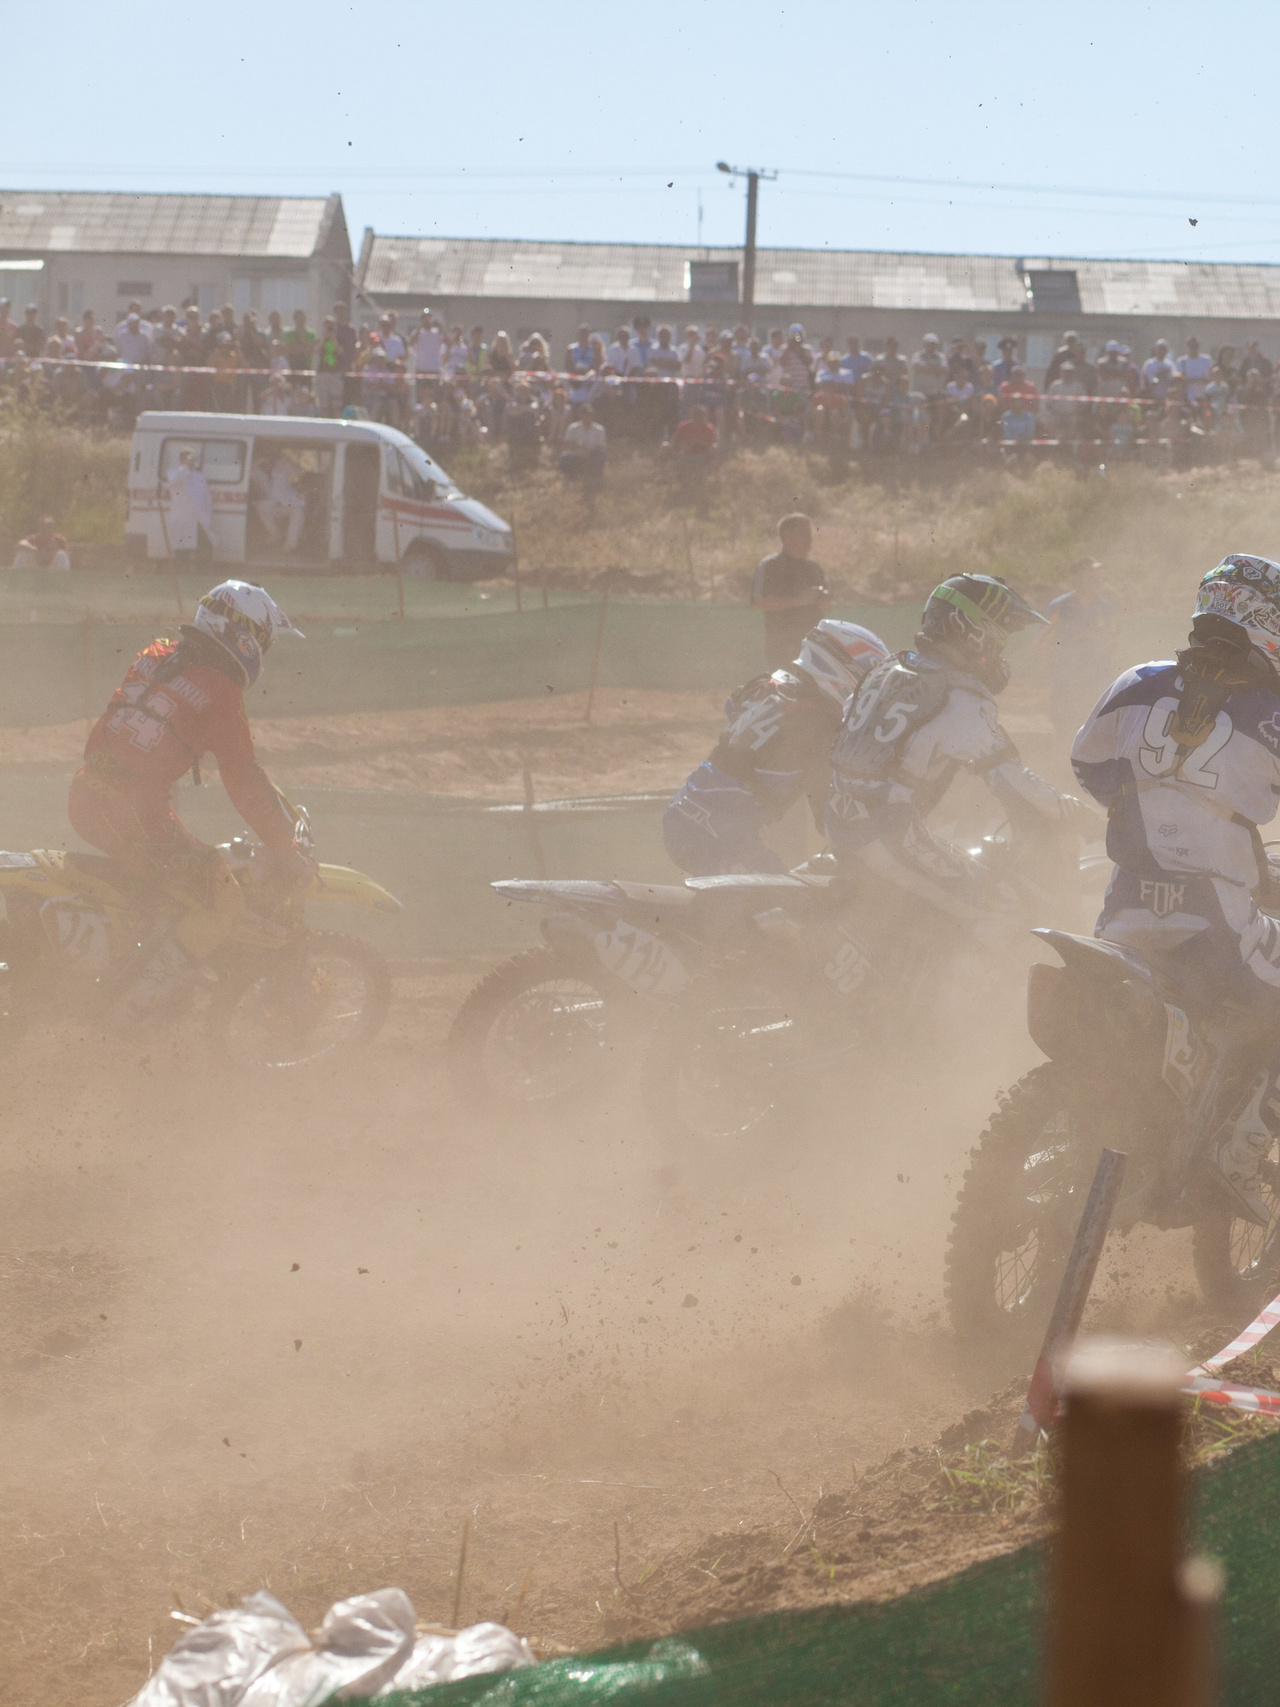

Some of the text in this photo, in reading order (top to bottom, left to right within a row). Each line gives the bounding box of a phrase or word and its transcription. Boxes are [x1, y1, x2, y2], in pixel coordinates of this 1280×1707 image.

[107, 682, 178, 752] 14
[848, 689, 918, 743] 95
[1139, 696, 1234, 790] 92
[1139, 879, 1187, 918] FOX
